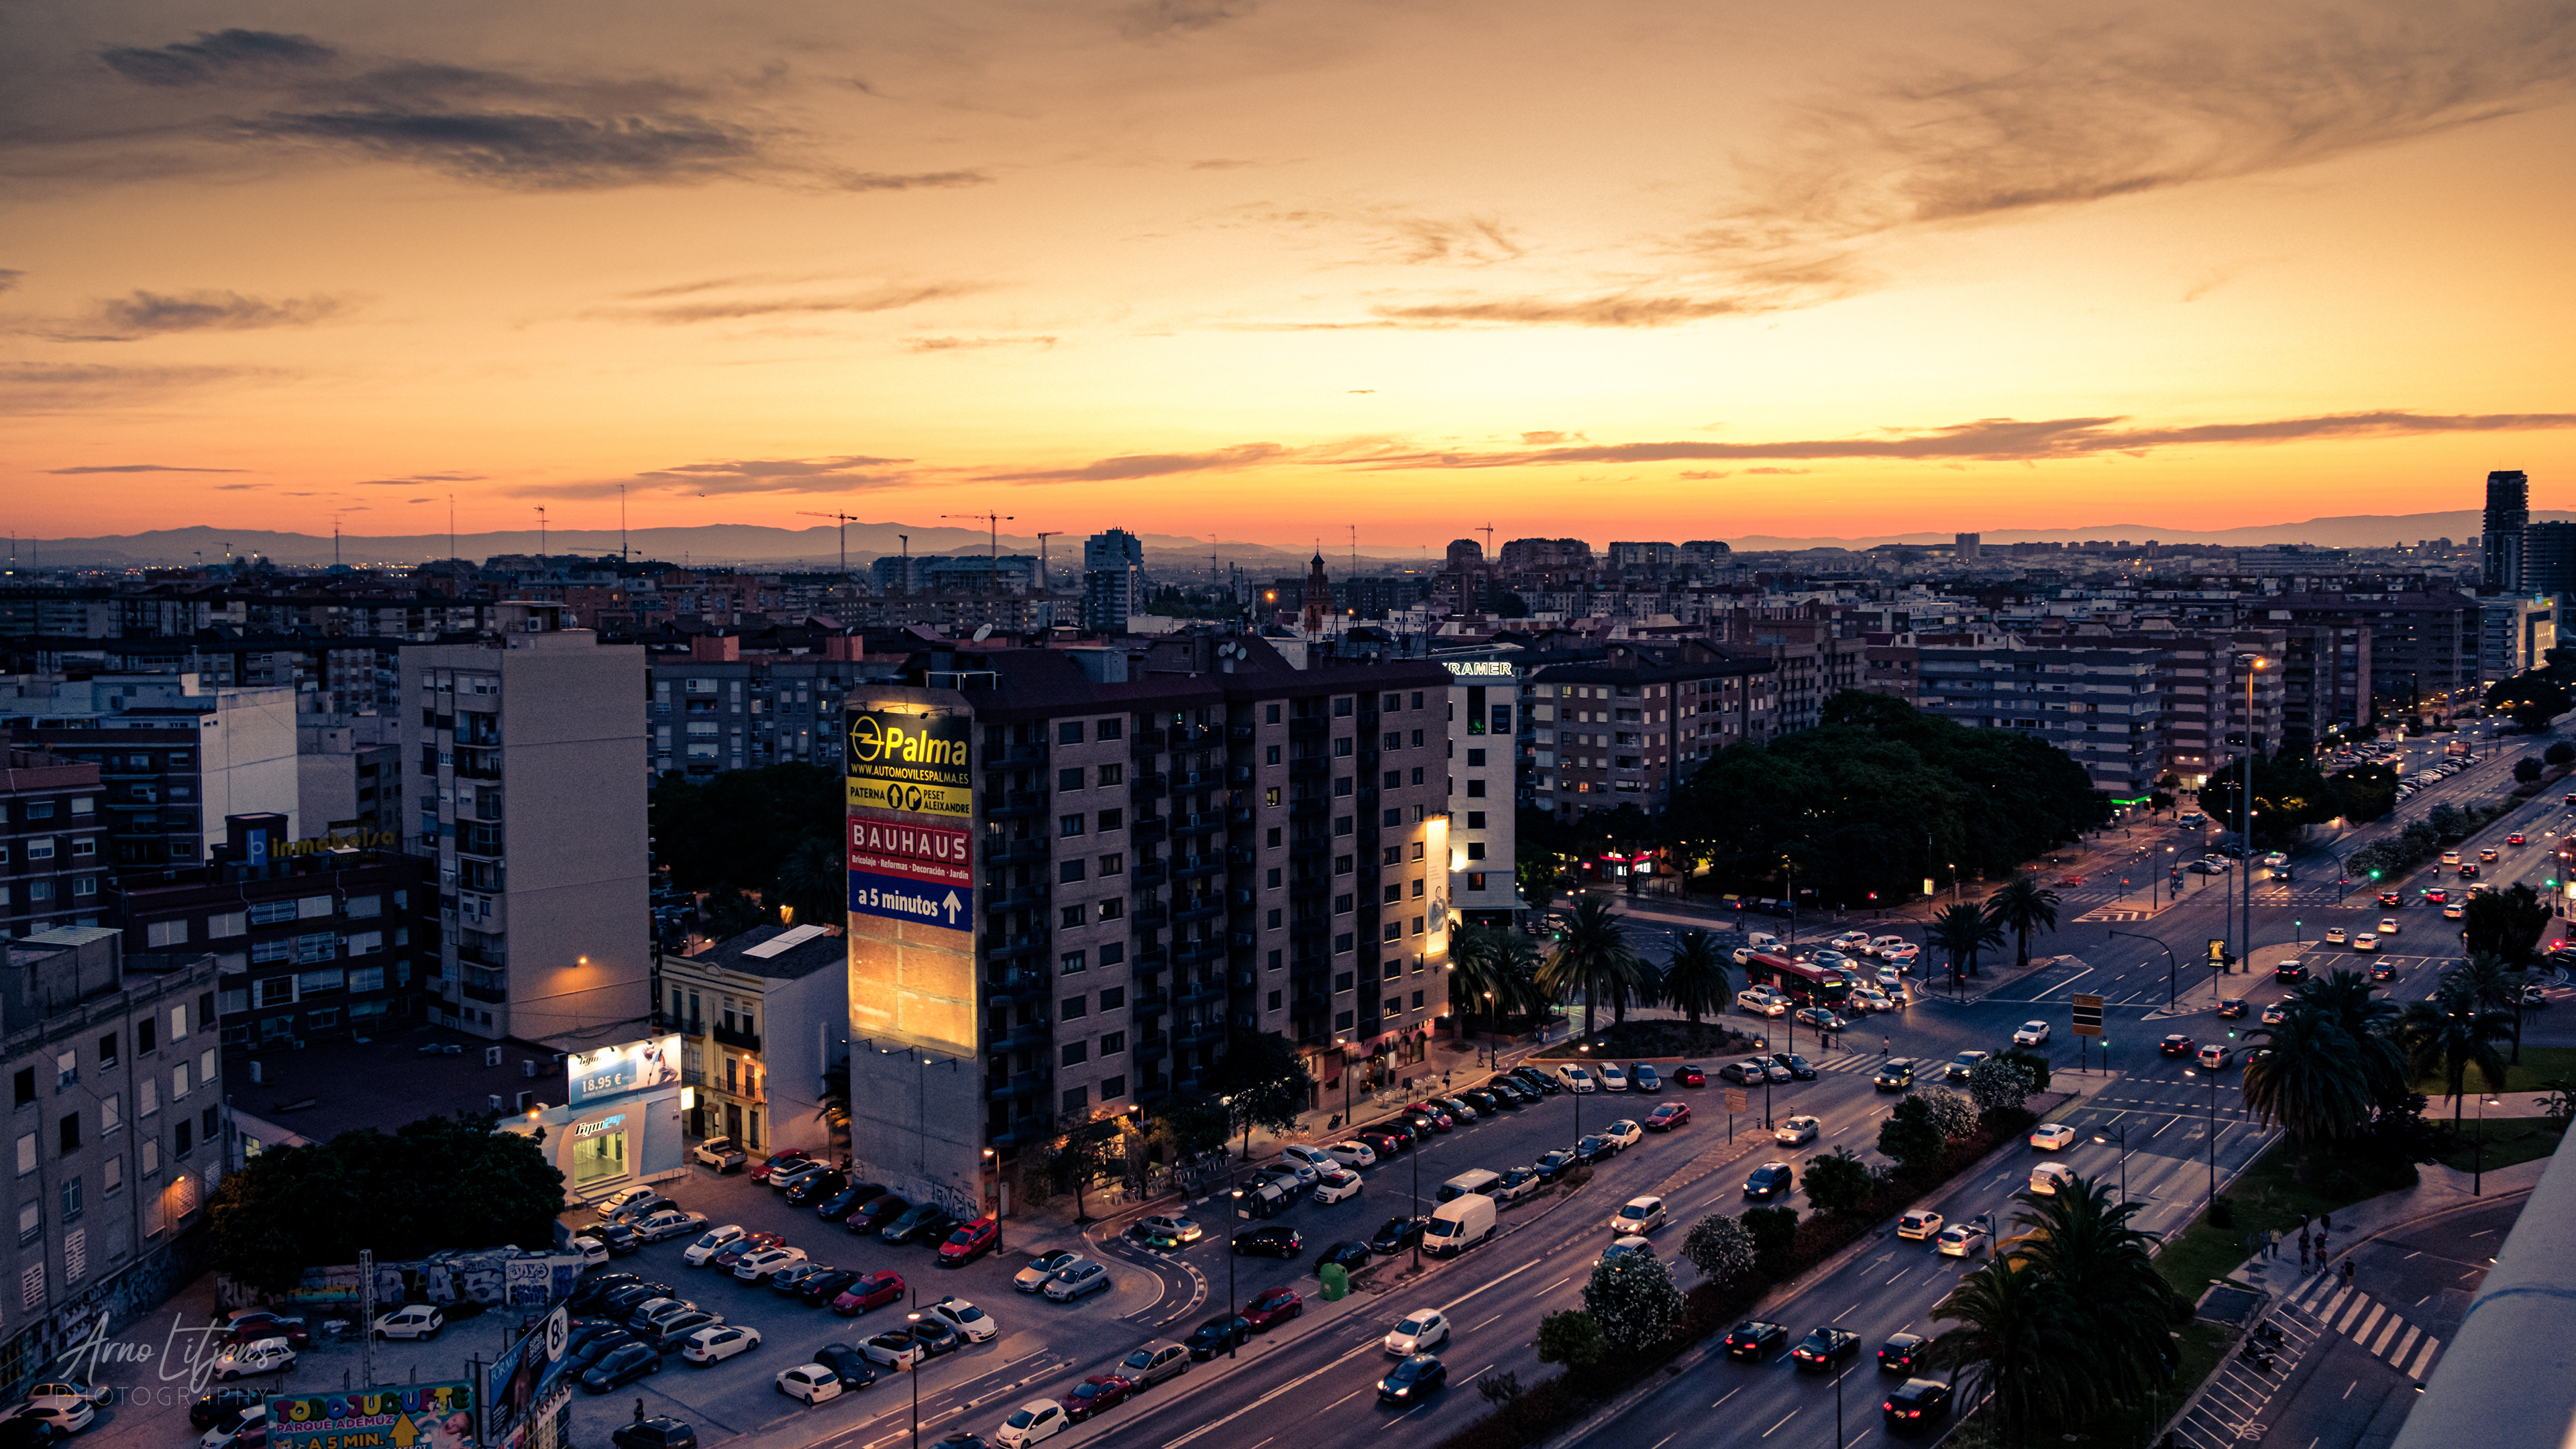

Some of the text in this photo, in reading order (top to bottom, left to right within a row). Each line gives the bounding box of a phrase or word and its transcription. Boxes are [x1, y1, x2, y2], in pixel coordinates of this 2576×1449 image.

[1442, 662, 1512, 675] RAMER
[885, 727, 967, 765] Palma
[851, 763, 969, 784] WWW.AUTOMOVILESPALMA.ES
[850, 786, 885, 800] PATERNA
[924, 790, 945, 800] PESET
[924, 800, 970, 814] ALEIXANDRE
[853, 824, 966, 860] BAUHAUS
[852, 855, 877, 867] Bricolaje
[881, 859, 908, 870] Reformas
[912, 863, 945, 876] Decoración
[859, 888, 938, 917] a 5 minutos
[582, 1075, 611, 1093] 18,95
[551, 1318, 560, 1350] 8
[273, 1385, 471, 1423] TODOJUGUETE
[276, 1415, 394, 1434] PARQUE ADEMUZ
[308, 1432, 385, 1449] A 5 MIN.
